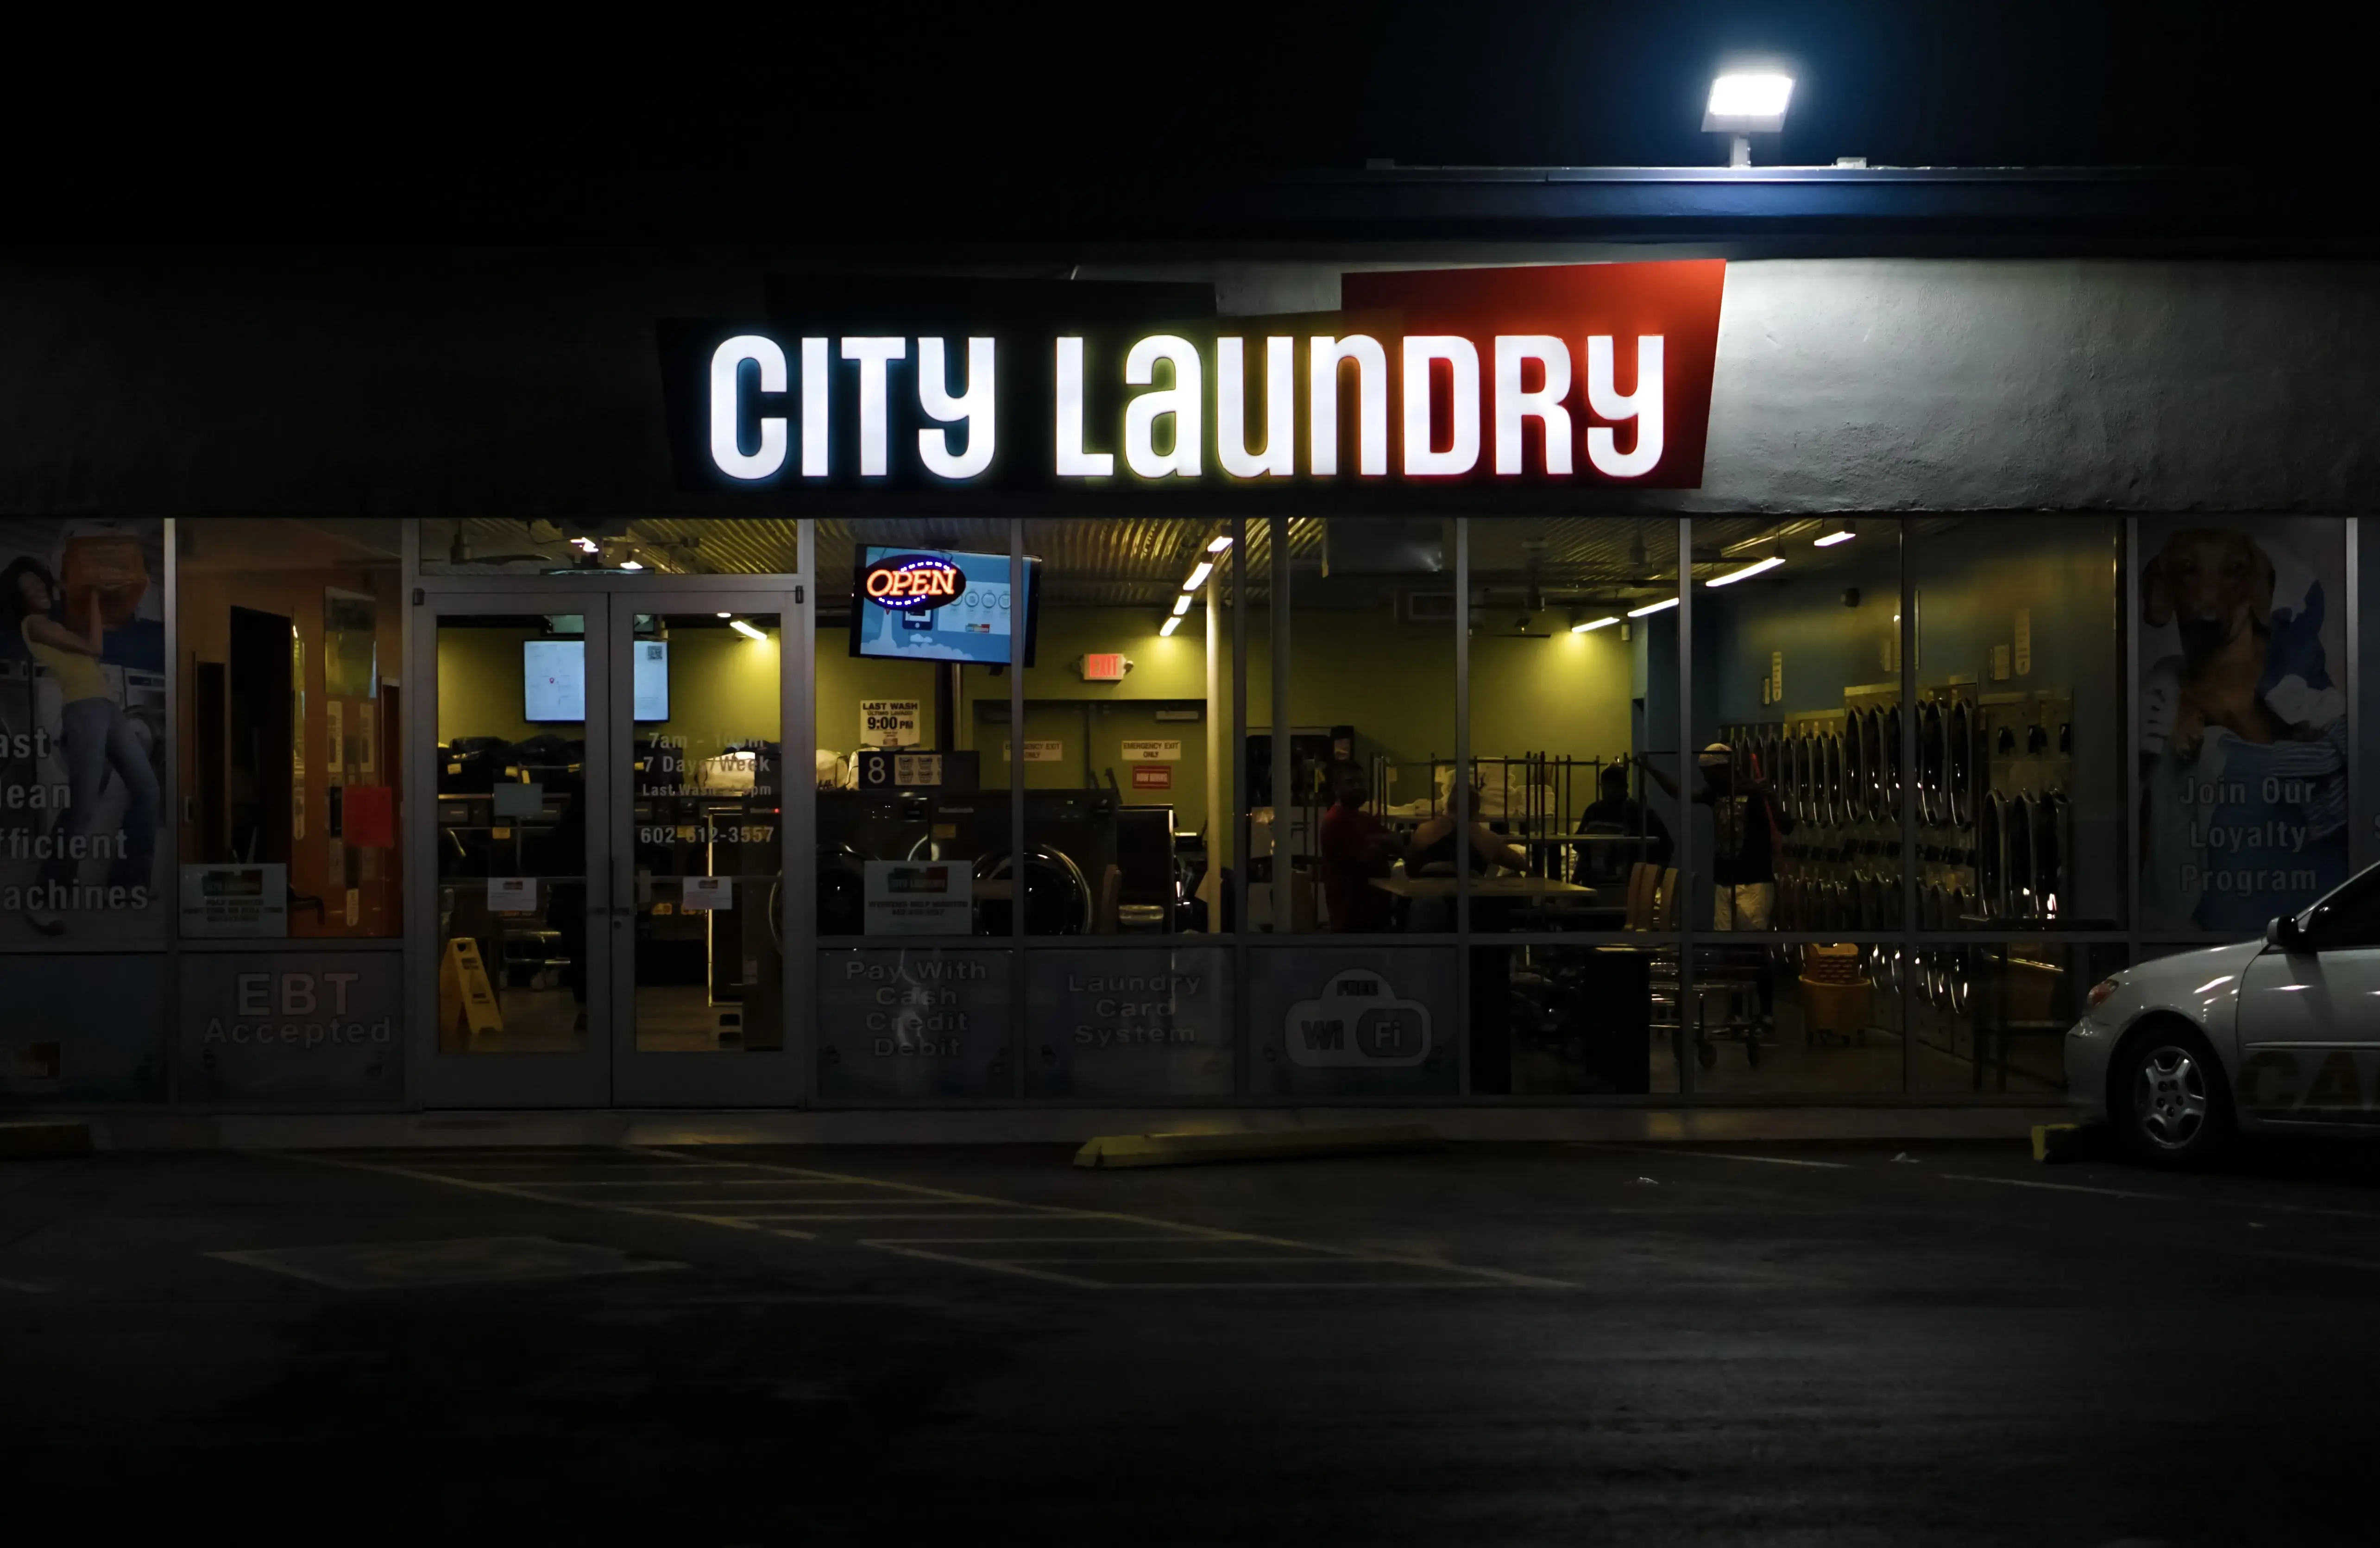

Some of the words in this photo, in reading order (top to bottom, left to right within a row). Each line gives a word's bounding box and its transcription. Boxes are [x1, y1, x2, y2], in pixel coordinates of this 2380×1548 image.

[867, 569, 957, 596] OPEN
[1089, 654, 1118, 676] EXIT
[867, 716, 898, 729] 9:00
[900, 720, 913, 729] PM
[649, 731, 687, 749] 7am
[643, 756, 654, 773] 7
[868, 756, 886, 784] 8
[0, 784, 71, 809] ean
[643, 784, 674, 796] Last
[2179, 776, 2246, 804] Join
[2262, 777, 2316, 804] Our
[2190, 820, 2307, 853] Loyalty
[2180, 864, 2316, 897] Program
[846, 960, 904, 984] Pay
[916, 960, 986, 979] With
[1068, 973, 1201, 995] Laundry
[237, 973, 359, 1016] EBT
[876, 986, 957, 1005] Cash
[1337, 980, 1378, 996] FREE
[1096, 998, 1176, 1017] Card
[203, 1017, 390, 1049] Accepted
[866, 1011, 968, 1031] Credit
[875, 1036, 961, 1056] Debit
[1075, 1024, 1195, 1048] System
[1375, 1021, 1400, 1048] Fi
[2235, 1051, 2380, 1121] CA
